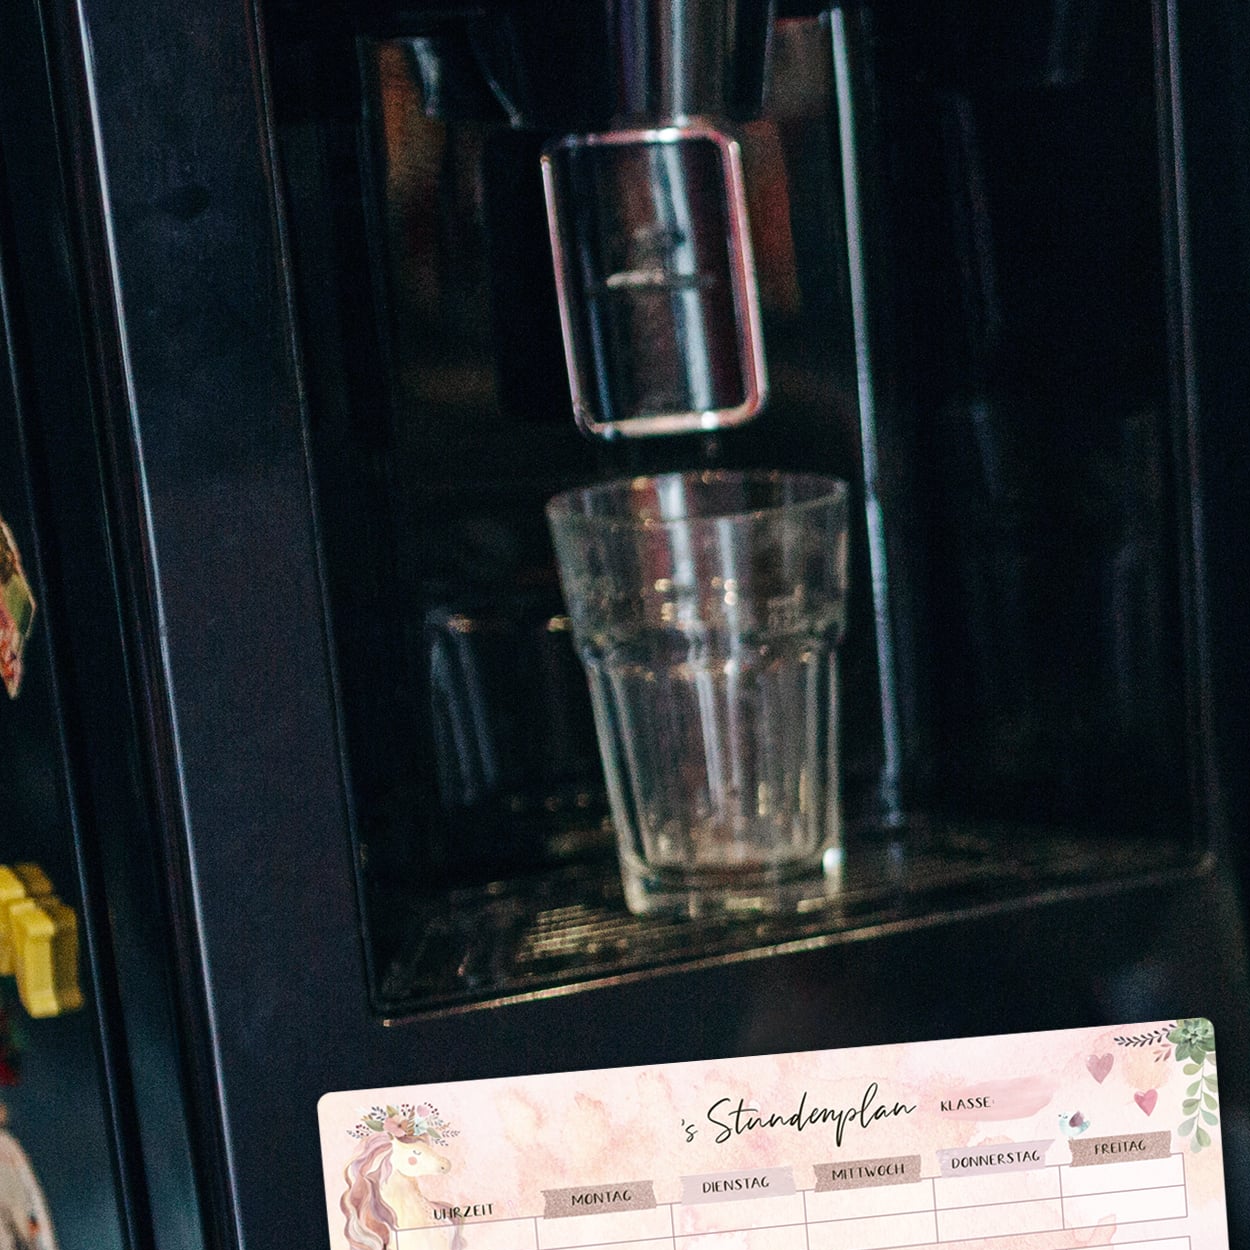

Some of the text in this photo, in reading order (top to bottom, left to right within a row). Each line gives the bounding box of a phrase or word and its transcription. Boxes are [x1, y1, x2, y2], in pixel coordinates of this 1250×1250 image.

[706, 1082, 917, 1147] Stundenplan
[1094, 1139, 1147, 1155] FREITAG
[951, 1150, 1041, 1169] DONNERSTAG
[831, 1163, 905, 1181] MITTWOCH
[702, 1176, 770, 1194] DIENSTAG
[571, 1189, 632, 1206] MONTAG
[433, 1203, 494, 1221] UHRZEIT
